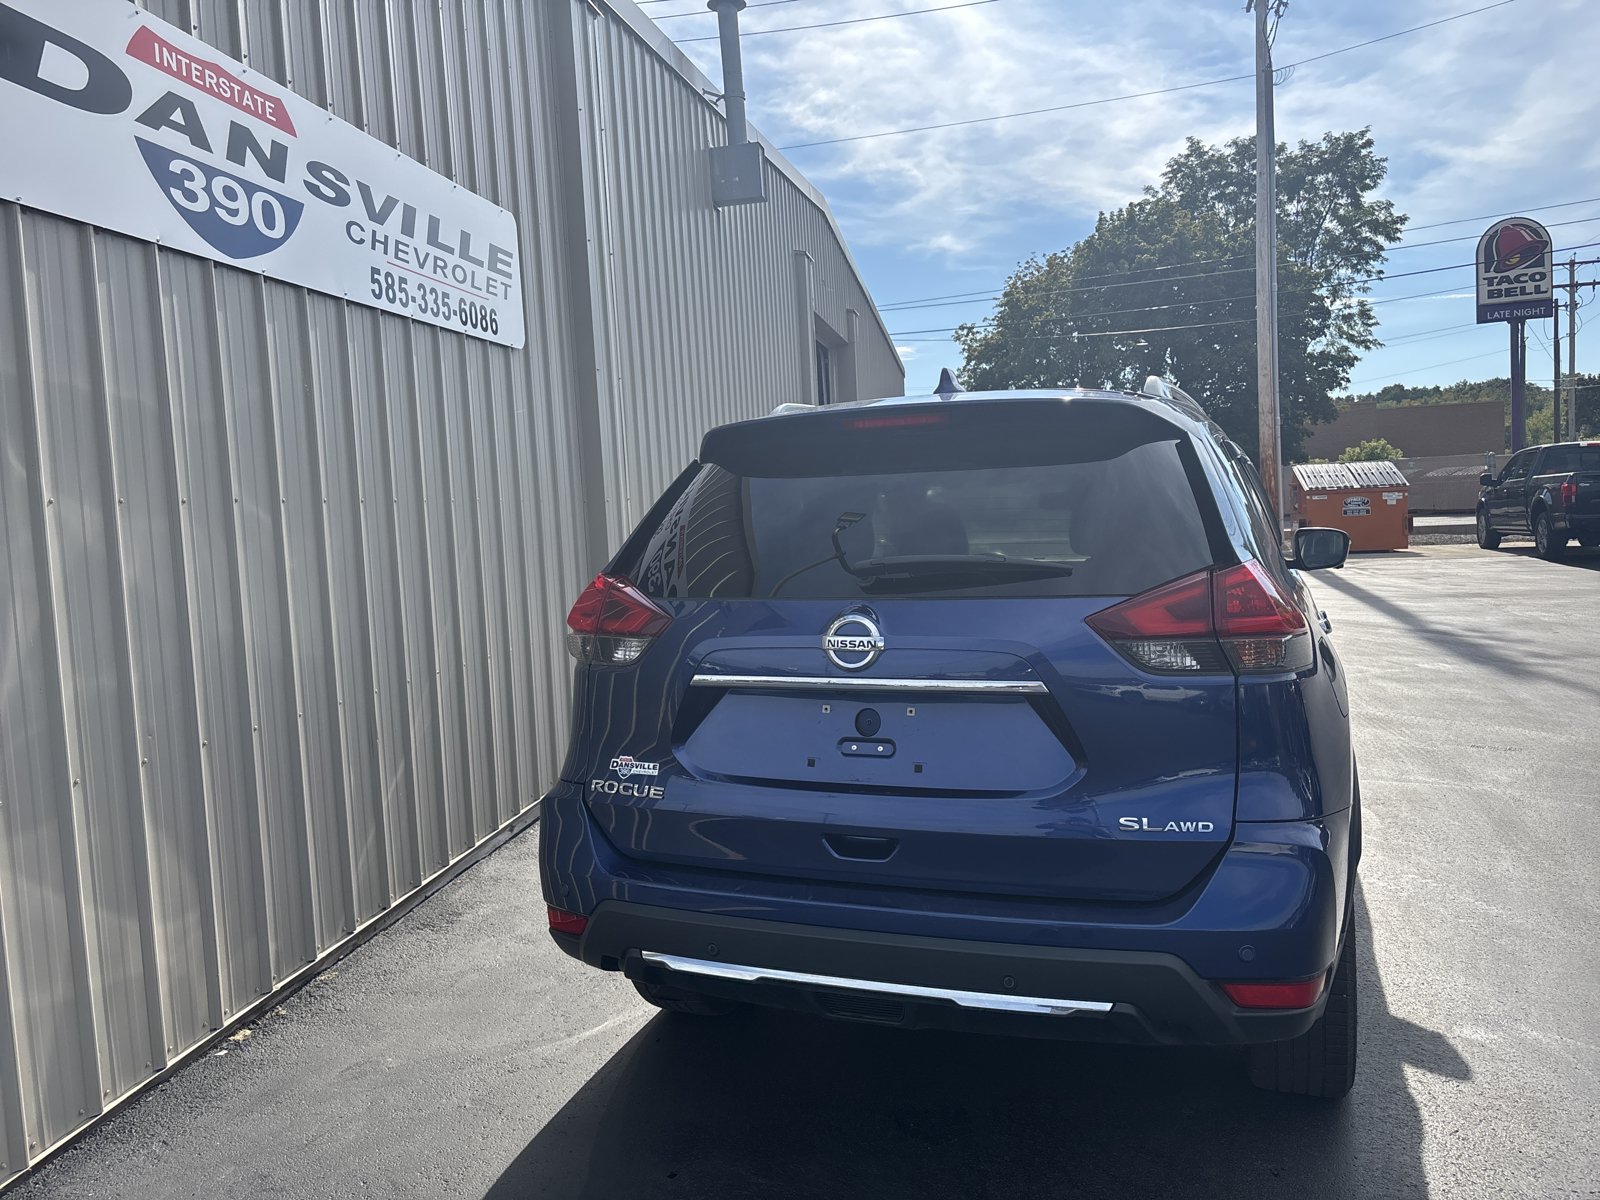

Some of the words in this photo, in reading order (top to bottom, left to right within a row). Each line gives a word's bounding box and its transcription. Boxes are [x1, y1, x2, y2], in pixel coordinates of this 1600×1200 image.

[154, 42, 277, 122] INTERSTATE
[0, 2, 514, 281] DANSVILLE
[168, 158, 286, 240] 390
[345, 220, 513, 301] CHEVROLET
[1482, 271, 1547, 287] TACO
[370, 265, 499, 336] 585-335-6086
[1487, 285, 1548, 299] BELL
[1487, 310, 1511, 320] LATE
[1513, 306, 1546, 317] NIGHT
[827, 639, 877, 649] NISSAN
[611, 760, 658, 771] DANSVILLE
[590, 779, 665, 799] ROGUE
[1118, 816, 1163, 832] SL
[1163, 821, 1214, 833] AWD
